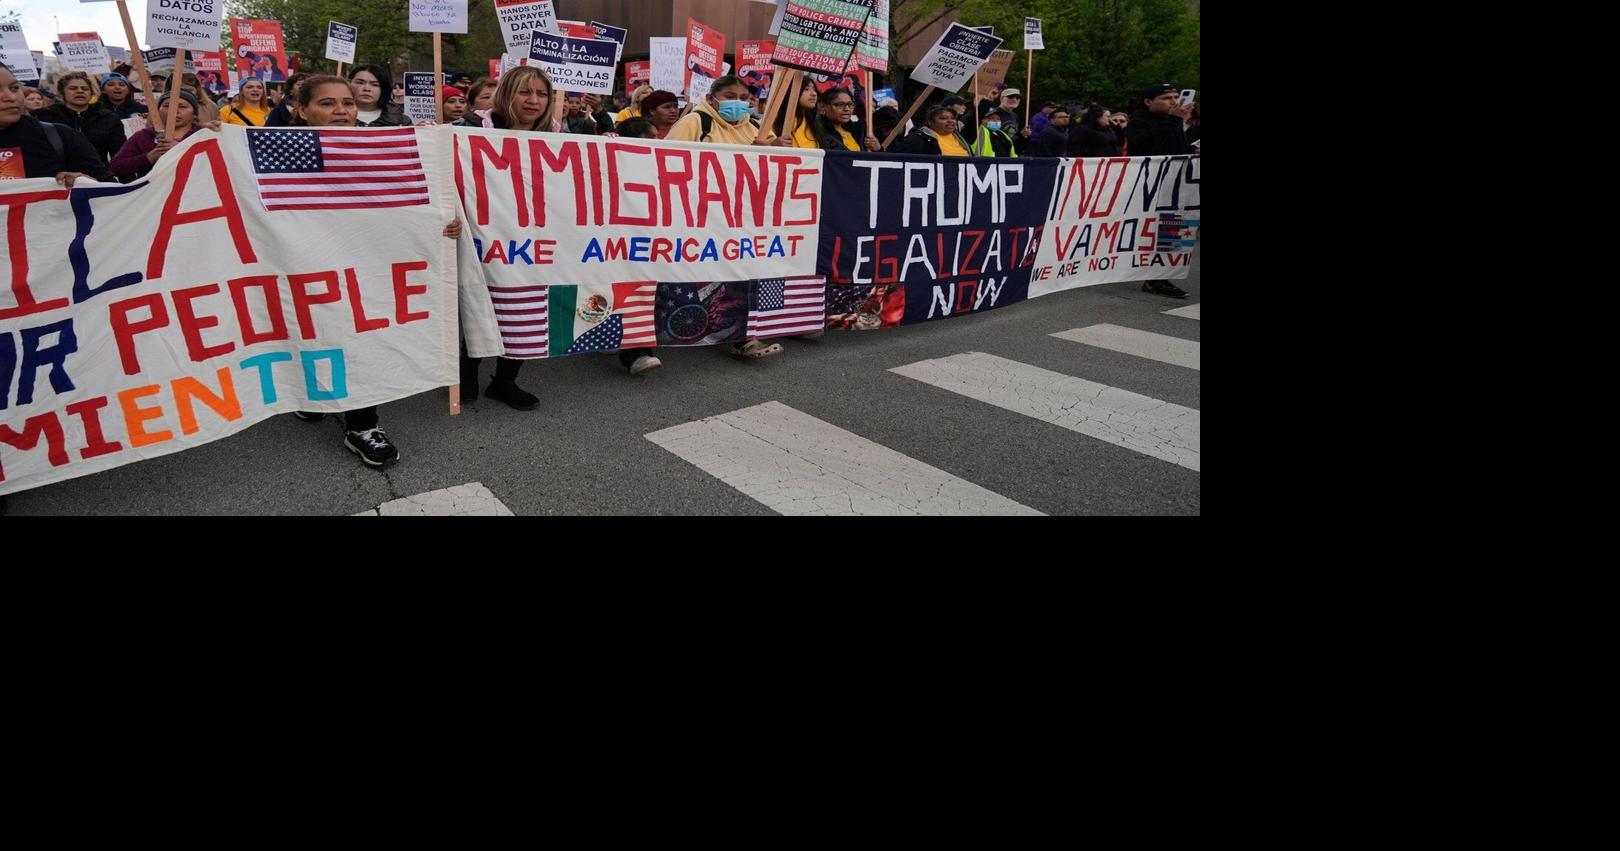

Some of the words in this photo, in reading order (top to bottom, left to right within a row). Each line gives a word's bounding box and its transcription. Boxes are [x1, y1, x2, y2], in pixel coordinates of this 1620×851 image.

[160, 0, 213, 14] DATOS
[500, 6, 530, 15] HANDS
[531, 3, 548, 11] OFF
[151, 13, 218, 27] RECHAZAMOS
[501, 10, 551, 23] TAXPAYER
[798, 8, 825, 20] POLICE
[827, 16, 862, 29] CRIMES
[510, 19, 547, 31] DATA!
[799, 18, 837, 33] LGBTQIA+
[839, 28, 859, 38] AND
[157, 27, 210, 39] VIGILANCIA
[823, 32, 856, 46] RIGHTS
[532, 38, 559, 50] ¡ALTO
[561, 43, 569, 51] A
[572, 44, 588, 54] LA
[743, 47, 759, 55] STOP
[949, 42, 981, 56] OBRERA!
[956, 39, 981, 50] CLASE
[69, 48, 99, 56] DATOS
[148, 48, 171, 58] STOP
[531, 47, 609, 64] CRIMINALIZACIÓN!
[788, 48, 836, 65] EDUCATION
[814, 46, 850, 60] STRIKE
[937, 48, 979, 66] PAGAMOS
[798, 59, 844, 74] FREEDOM
[928, 62, 953, 74] ¡PAGA
[954, 69, 966, 77] LA
[938, 57, 967, 70] CUOTA.
[575, 70, 583, 78] A
[586, 71, 610, 81] LAS
[932, 69, 955, 80] TUYA!
[549, 76, 609, 89] ORTACIONES!
[852, 159, 1024, 229] TRUMP
[1055, 217, 1157, 261] VAMOS
[581, 236, 719, 264] AMERICA
[722, 234, 804, 261] GREAT
[1031, 265, 1053, 282] WE
[1056, 260, 1081, 278] ARE
[1088, 255, 1119, 272] NOT
[1131, 252, 1192, 268] LEAVI
[926, 275, 1008, 319] NOW
[109, 260, 430, 376] PEOPLE
